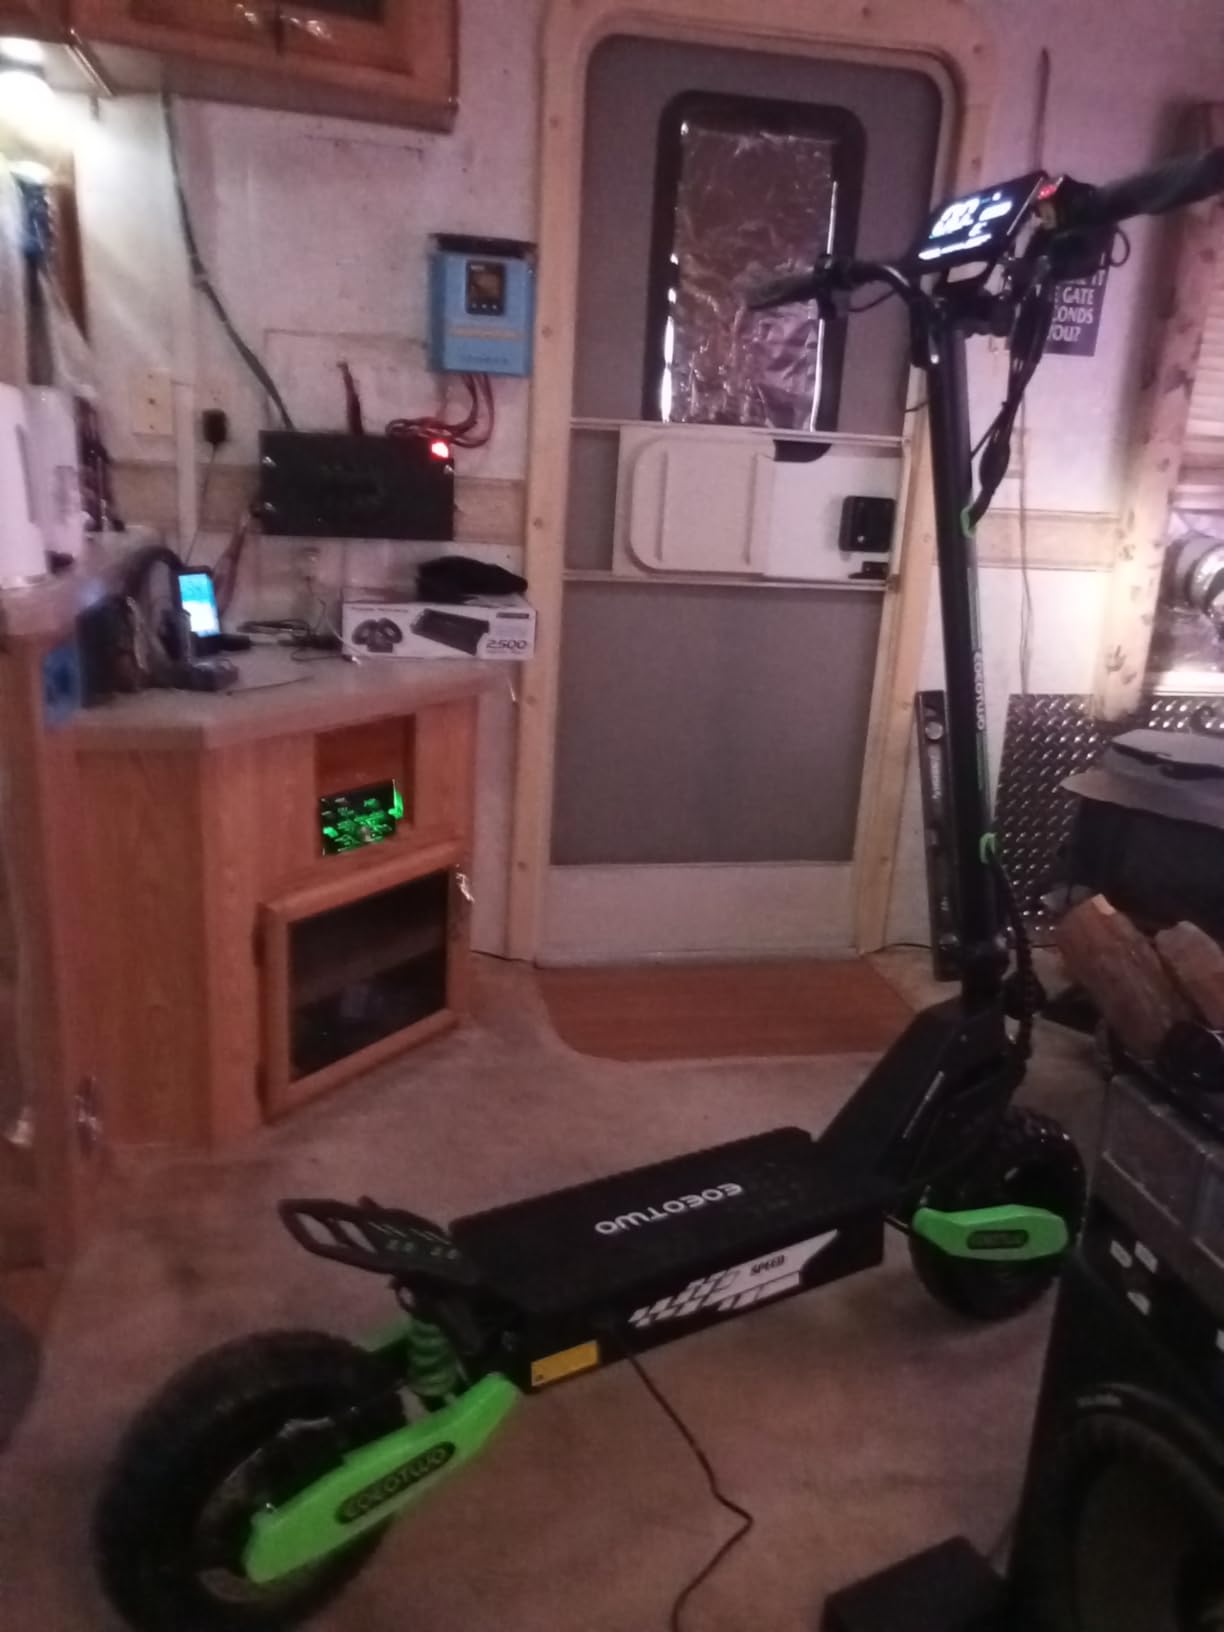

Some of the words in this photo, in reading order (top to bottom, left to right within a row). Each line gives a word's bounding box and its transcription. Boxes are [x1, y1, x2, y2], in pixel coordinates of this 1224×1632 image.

[1062, 286, 1095, 305] GATE
[486, 639, 528, 650] 2500
[594, 1183, 743, 1235] EOEOTWO
